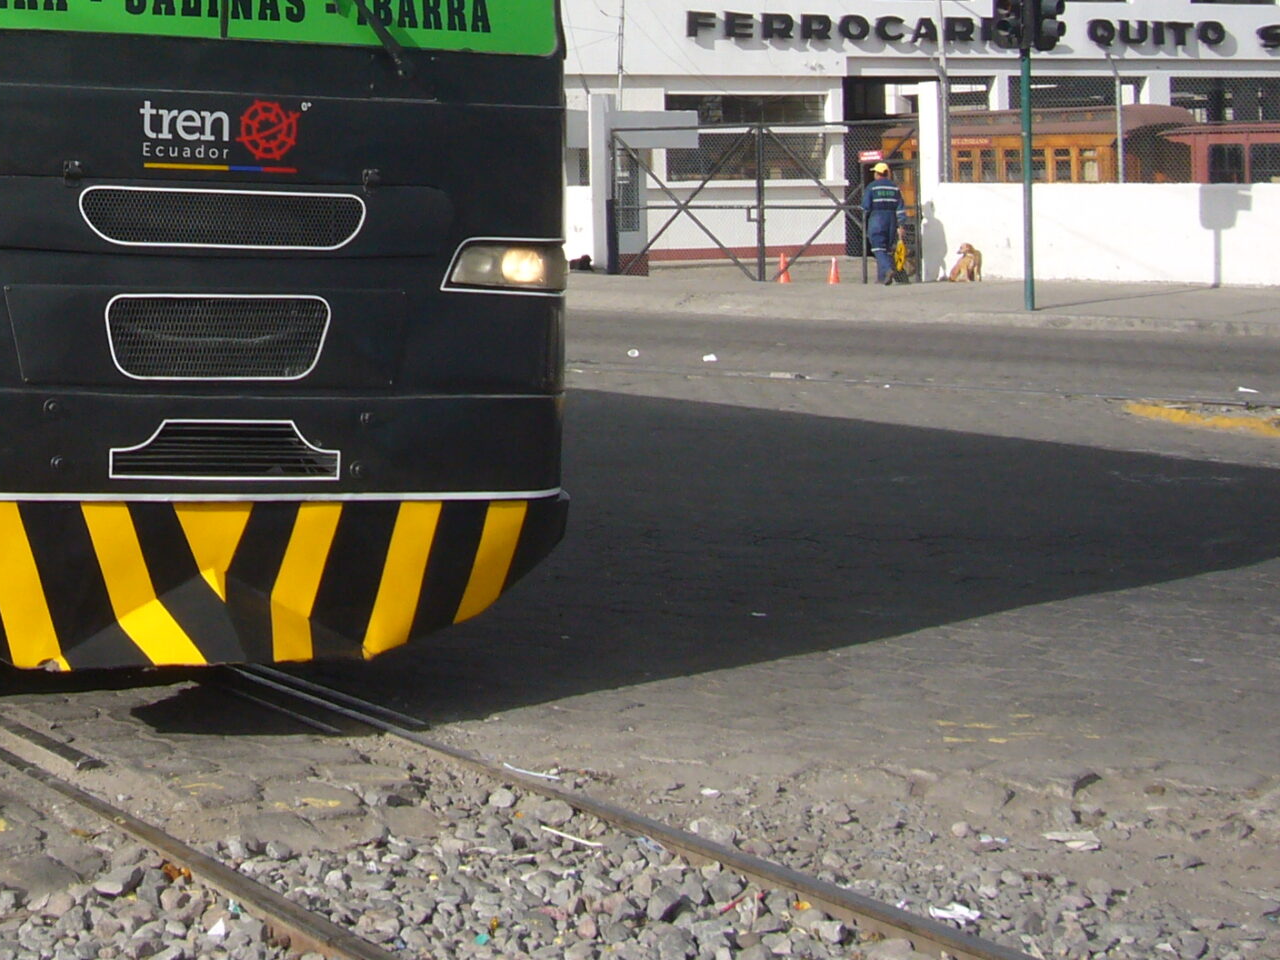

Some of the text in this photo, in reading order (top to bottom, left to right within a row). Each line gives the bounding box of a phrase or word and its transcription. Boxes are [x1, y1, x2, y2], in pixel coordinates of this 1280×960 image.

[1088, 18, 1226, 46] QUITO
[139, 100, 230, 142] tren
[142, 142, 230, 159] Ecuador
